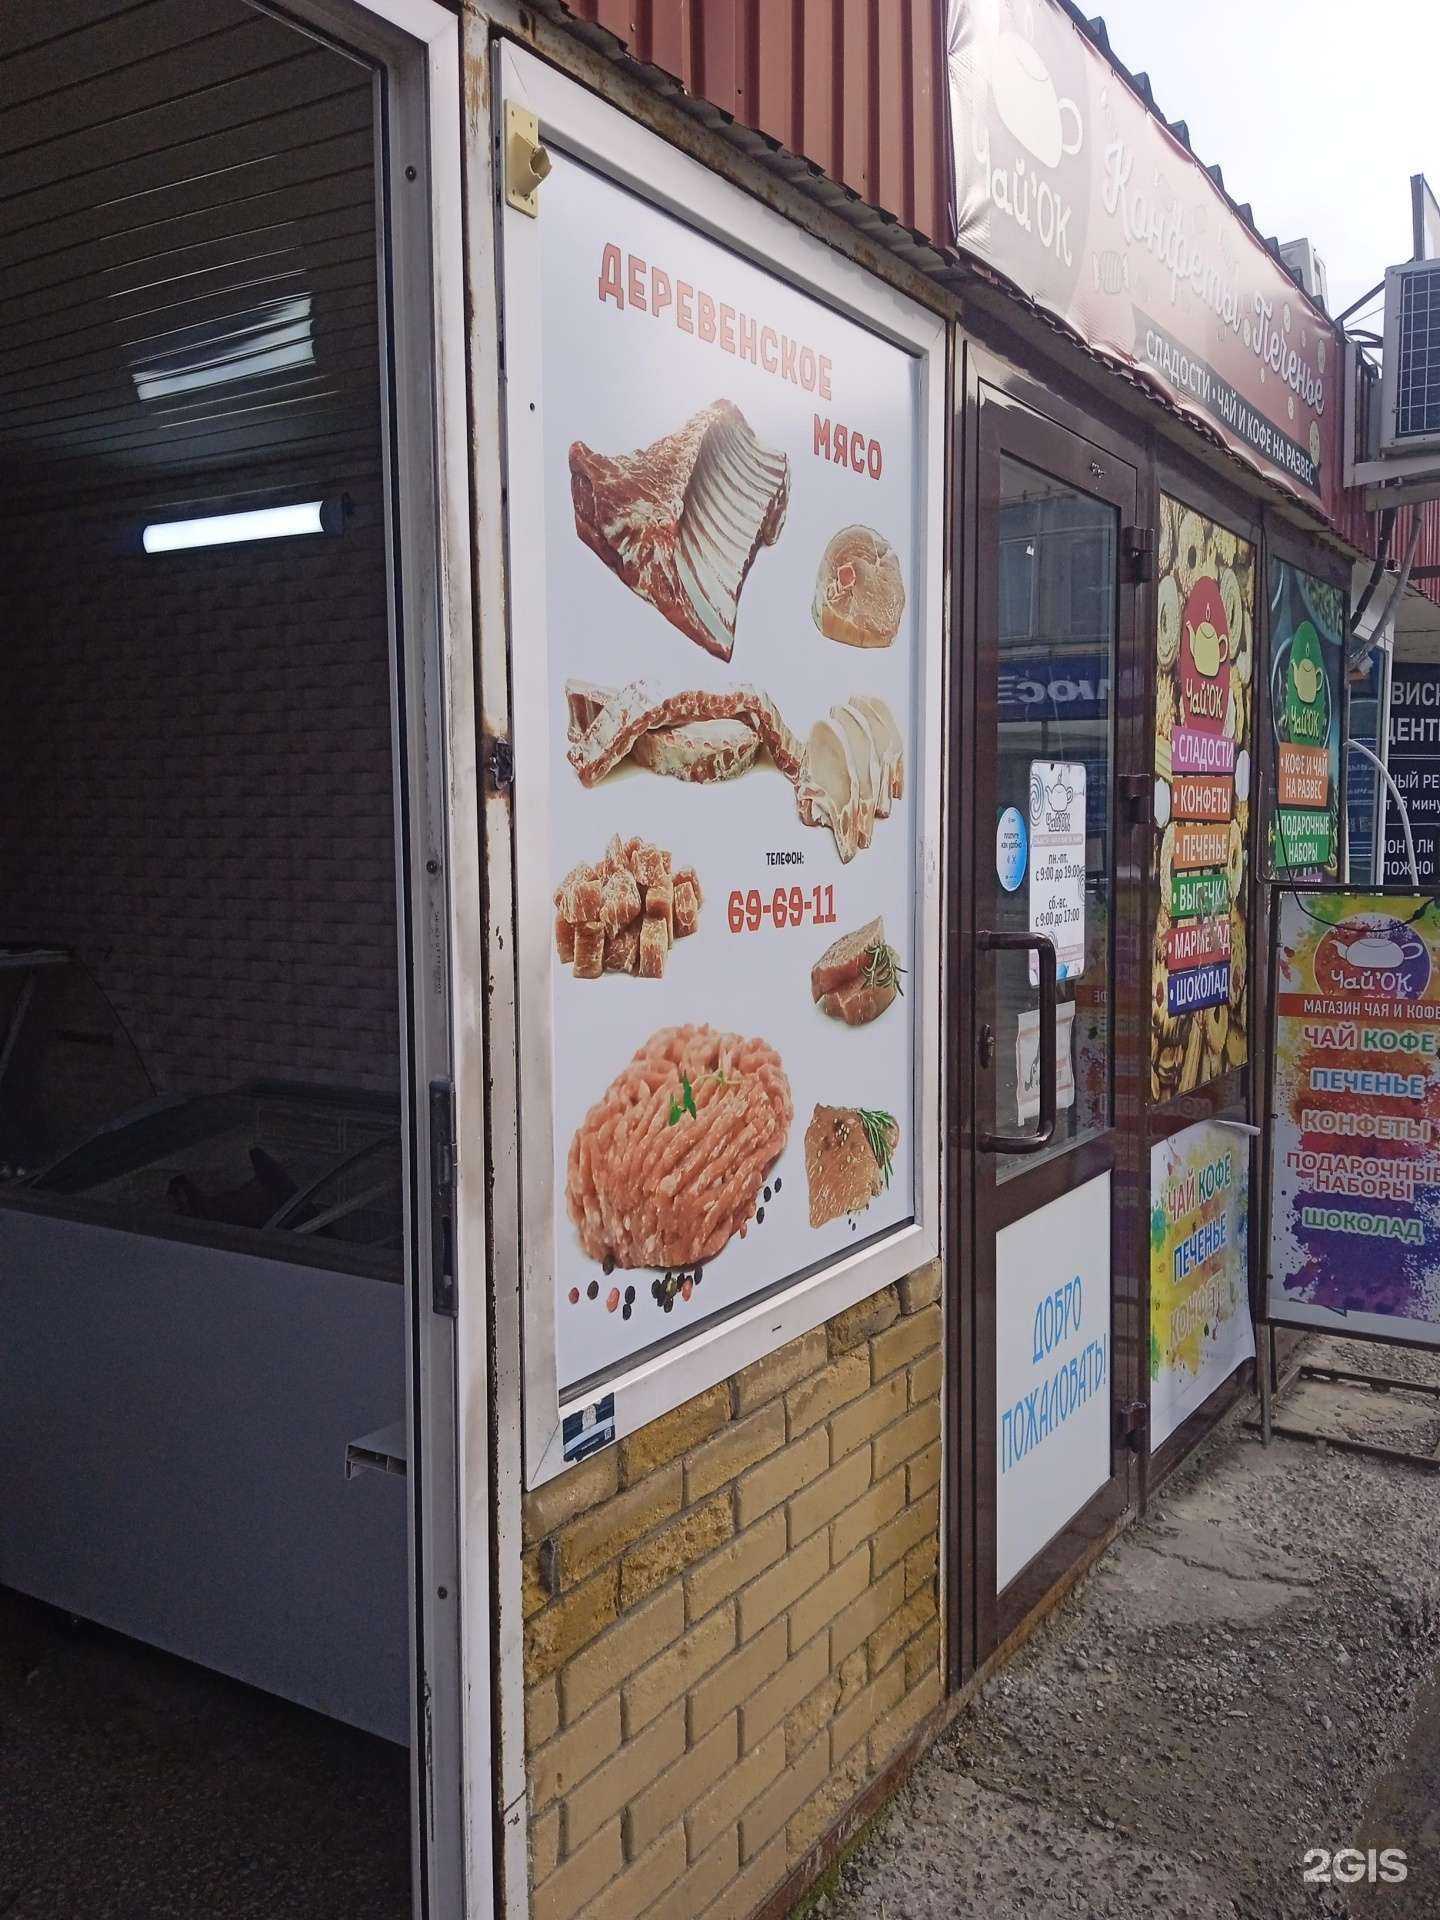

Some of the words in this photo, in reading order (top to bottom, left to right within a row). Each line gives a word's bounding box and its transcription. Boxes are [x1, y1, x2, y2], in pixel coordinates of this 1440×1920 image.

[598, 242, 832, 401] ДЕРЕВЕНСКОЕ
[1146, 330, 1211, 402] СЛАДОСТИ
[1217, 386, 1238, 426] ЧАЙ
[1238, 407, 1246, 434] И
[1247, 412, 1272, 454] КОФЕ
[1273, 433, 1285, 464] НА
[1286, 442, 1314, 485] РАЗВЕС
[813, 413, 883, 480] МЯСО
[1389, 718, 1440, 745] ЕНТ
[1178, 734, 1234, 772] СЛАДОСТИ
[1285, 753, 1305, 775] КОФЕ
[1306, 756, 1312, 776] И
[1313, 752, 1328, 778] ЧАЙ
[1180, 784, 1231, 814] КОНФЕТЫ
[1285, 777, 1297, 798] НА
[1298, 779, 1323, 800] РАЗВЕС
[1281, 814, 1330, 841] ПОДАРОЧНЫЕ
[766, 851, 804, 866] ТЕЛЕФОН:
[1182, 833, 1228, 861] ПЕЧЕНЬЕ
[1288, 841, 1319, 864] НАБОРЫ
[727, 884, 837, 933] 69-69-11
[1064, 908, 1079, 923] 17:00
[1174, 924, 1231, 960] МАРМЕАД
[1176, 967, 1229, 1006] ШОКОЛАД
[1304, 999, 1360, 1014] МАГАЗИН
[1364, 1003, 1389, 1017] ЧАЯ
[1393, 1004, 1402, 1018] И
[1407, 1004, 1440, 1020] КОФЕ
[1304, 1023, 1355, 1048] ЧАЙ
[1363, 1030, 1435, 1053] КОФЕ
[1311, 1069, 1424, 1097] ПЕЧЕНЬЕ
[1303, 1110, 1430, 1141] КОНФЕТЫ
[1286, 1151, 1440, 1183] ПОДАРОЧНЫЕ
[1168, 1169, 1195, 1222] ЧАЙ
[1199, 1153, 1232, 1203] КОФЕ
[1316, 1174, 1413, 1199] НАБОРЫ
[1303, 1208, 1423, 1243] ШОКОЛАД
[1173, 1214, 1227, 1283] ПЕЧЕНЬЕ
[1033, 1275, 1082, 1365] ДОБРО
[1002, 1333, 1107, 1474] ПОЖАЛОВАТЬ!
